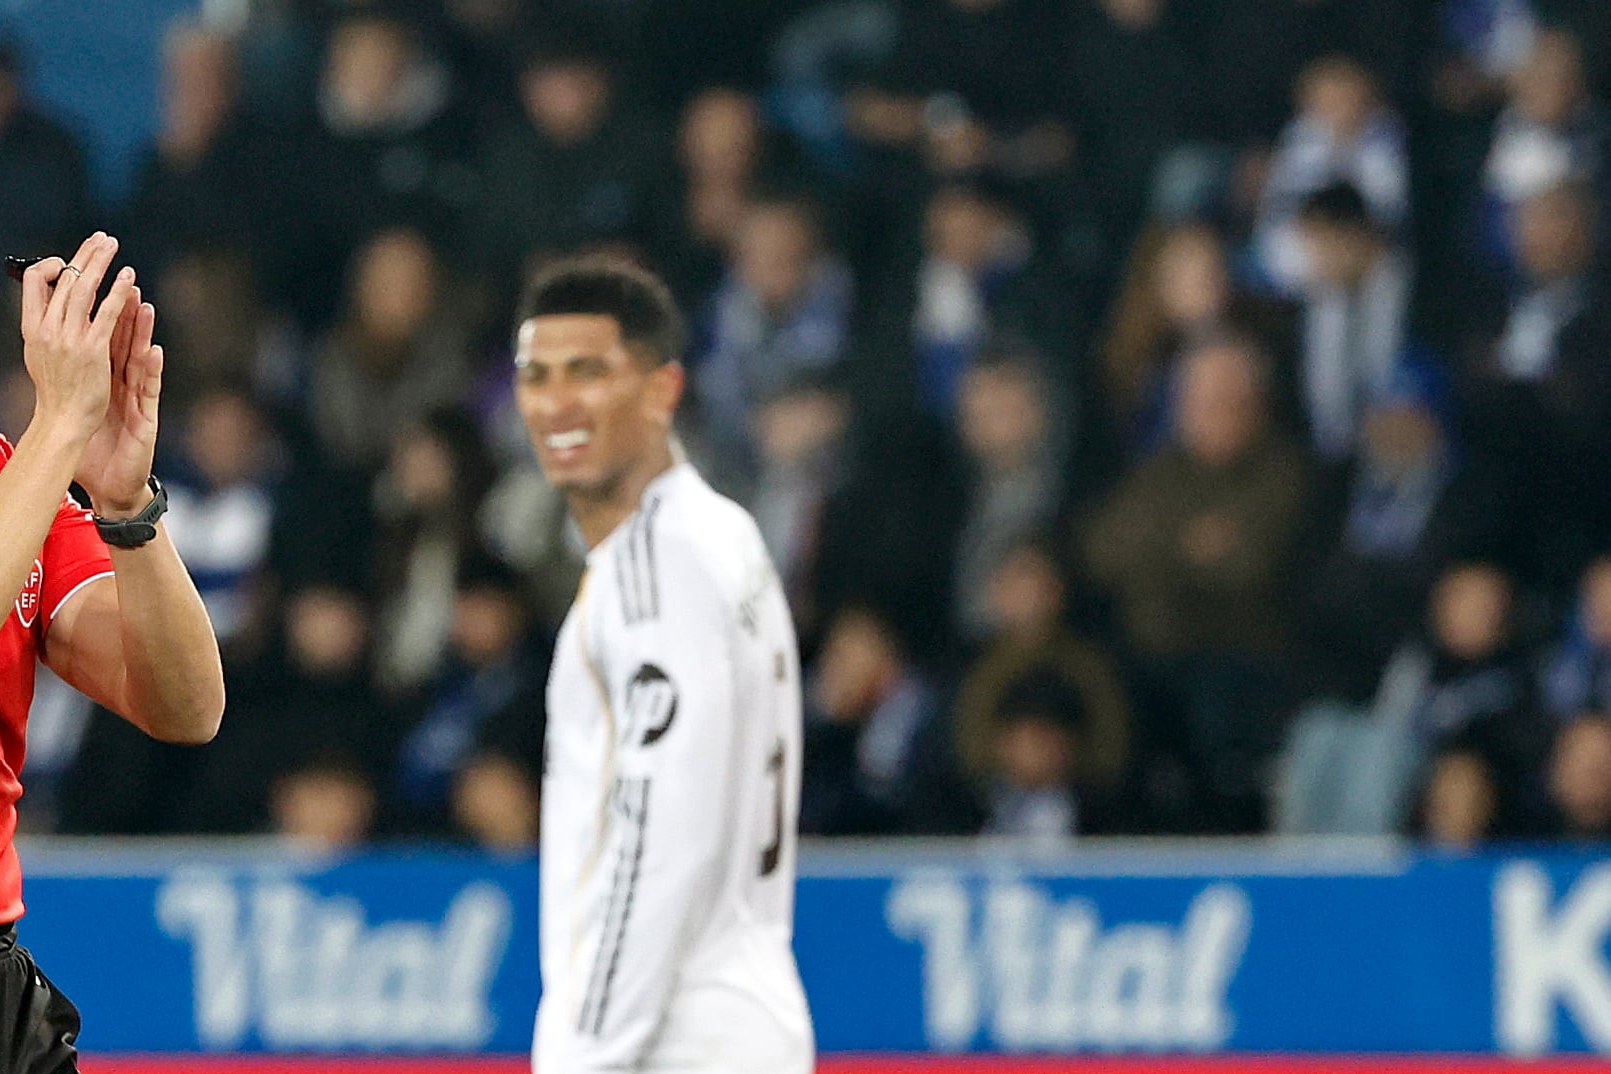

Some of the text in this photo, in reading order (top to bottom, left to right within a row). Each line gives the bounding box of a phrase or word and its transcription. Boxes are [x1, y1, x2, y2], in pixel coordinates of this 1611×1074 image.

[21, 592, 37, 609] EF
[25, 571, 39, 588] F
[156, 868, 513, 1048] Vital
[886, 868, 1250, 1049] Vital
